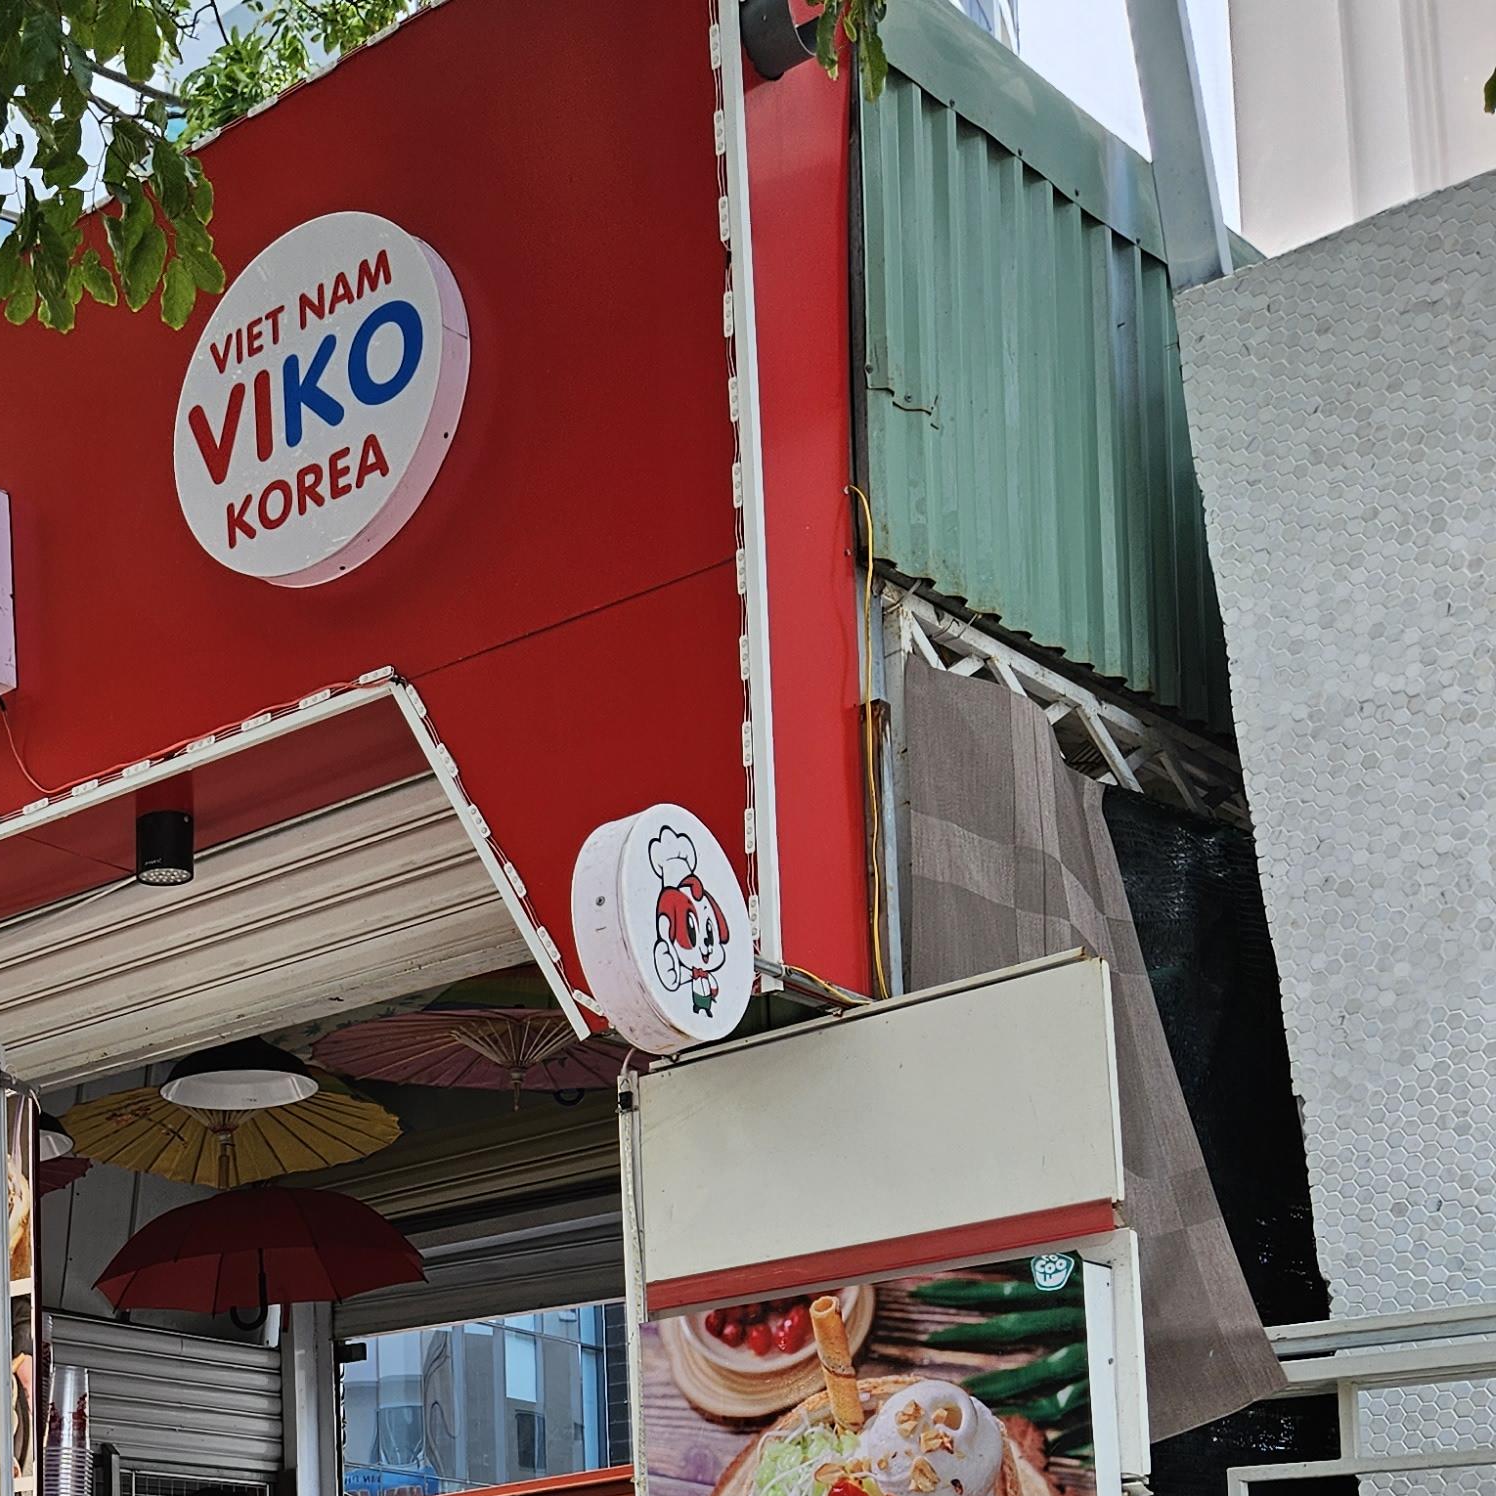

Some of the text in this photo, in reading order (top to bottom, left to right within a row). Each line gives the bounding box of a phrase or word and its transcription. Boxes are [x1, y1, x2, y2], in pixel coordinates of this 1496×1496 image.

[209, 249, 392, 374] VIET NAM
[188, 300, 423, 485] VIKO
[226, 433, 389, 549] KOREA
